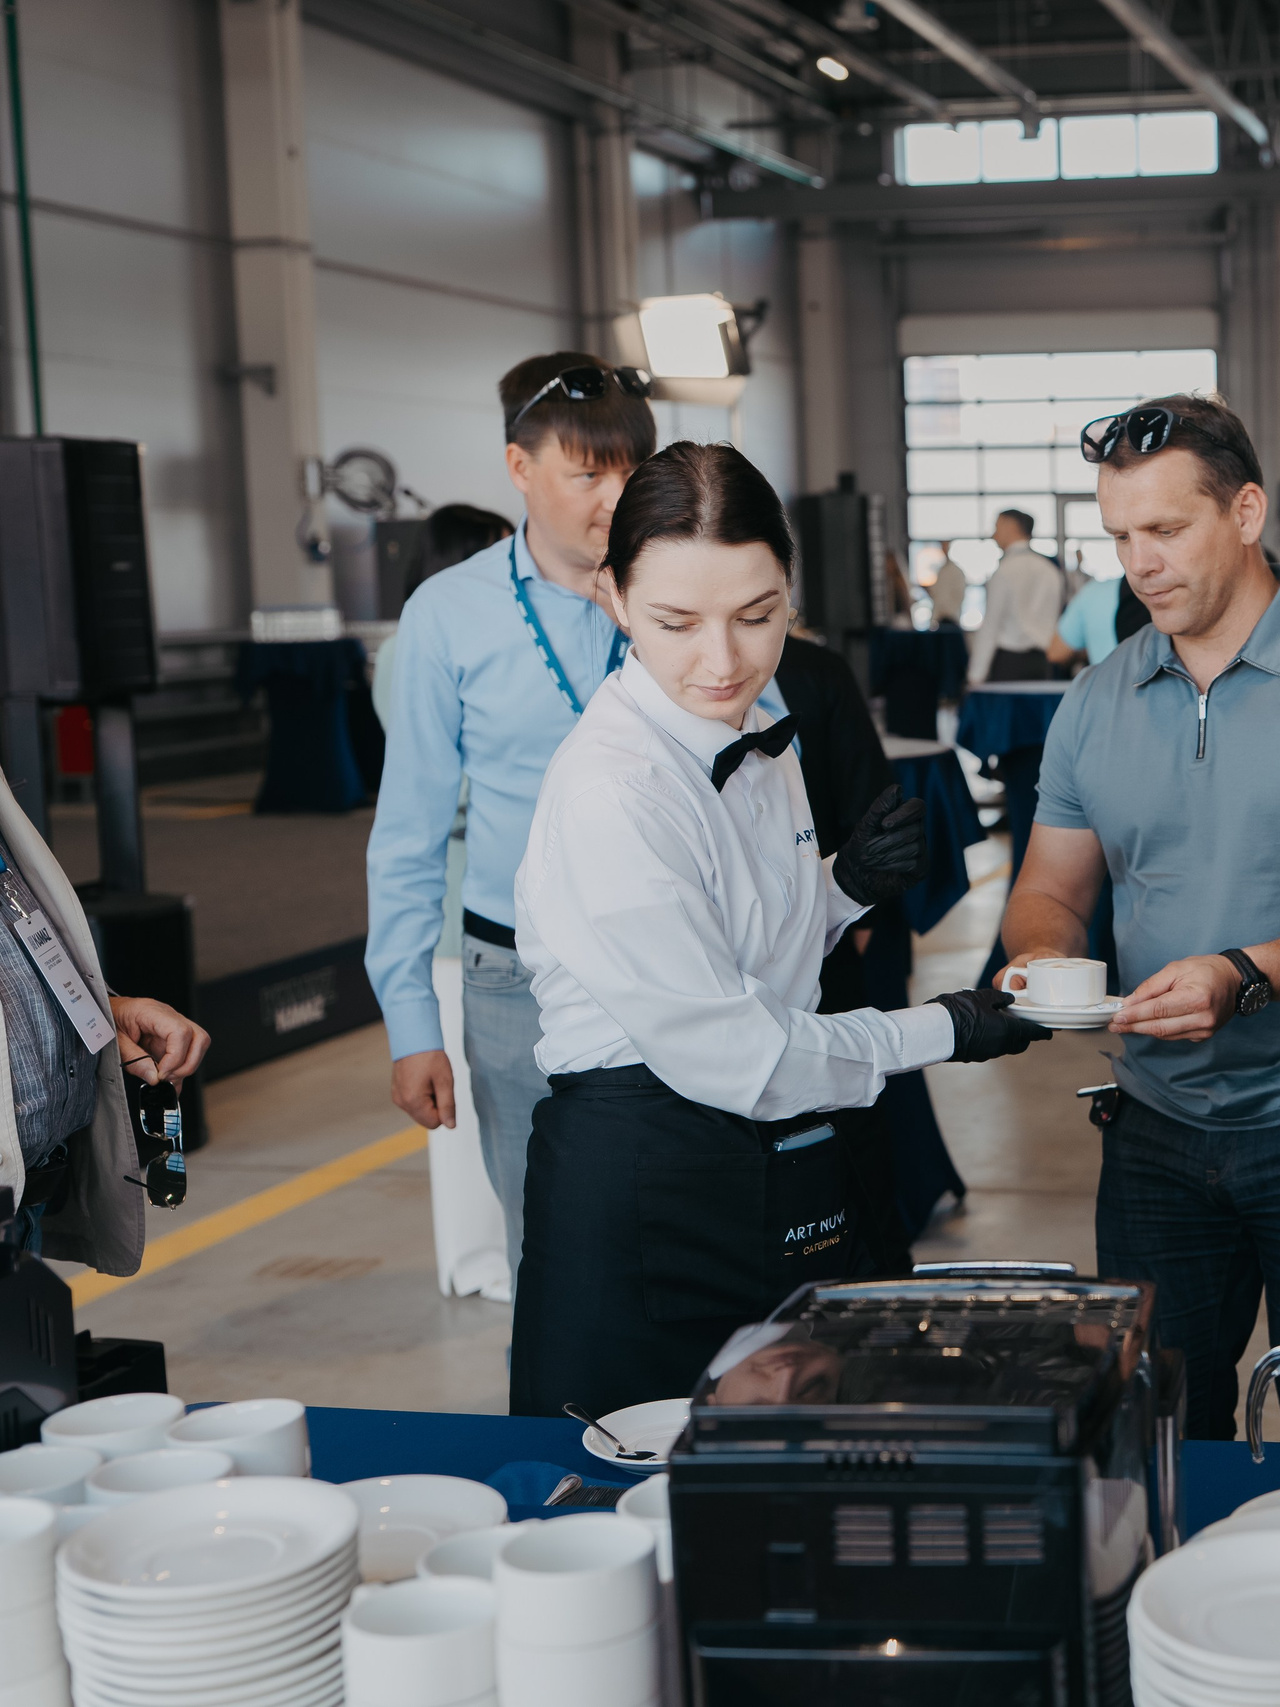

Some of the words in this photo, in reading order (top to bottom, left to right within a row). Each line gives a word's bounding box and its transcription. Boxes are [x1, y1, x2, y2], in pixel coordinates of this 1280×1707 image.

[785, 1222, 816, 1242] ART
[820, 1209, 845, 1233] NUV
[803, 1235, 840, 1255] CATERING
